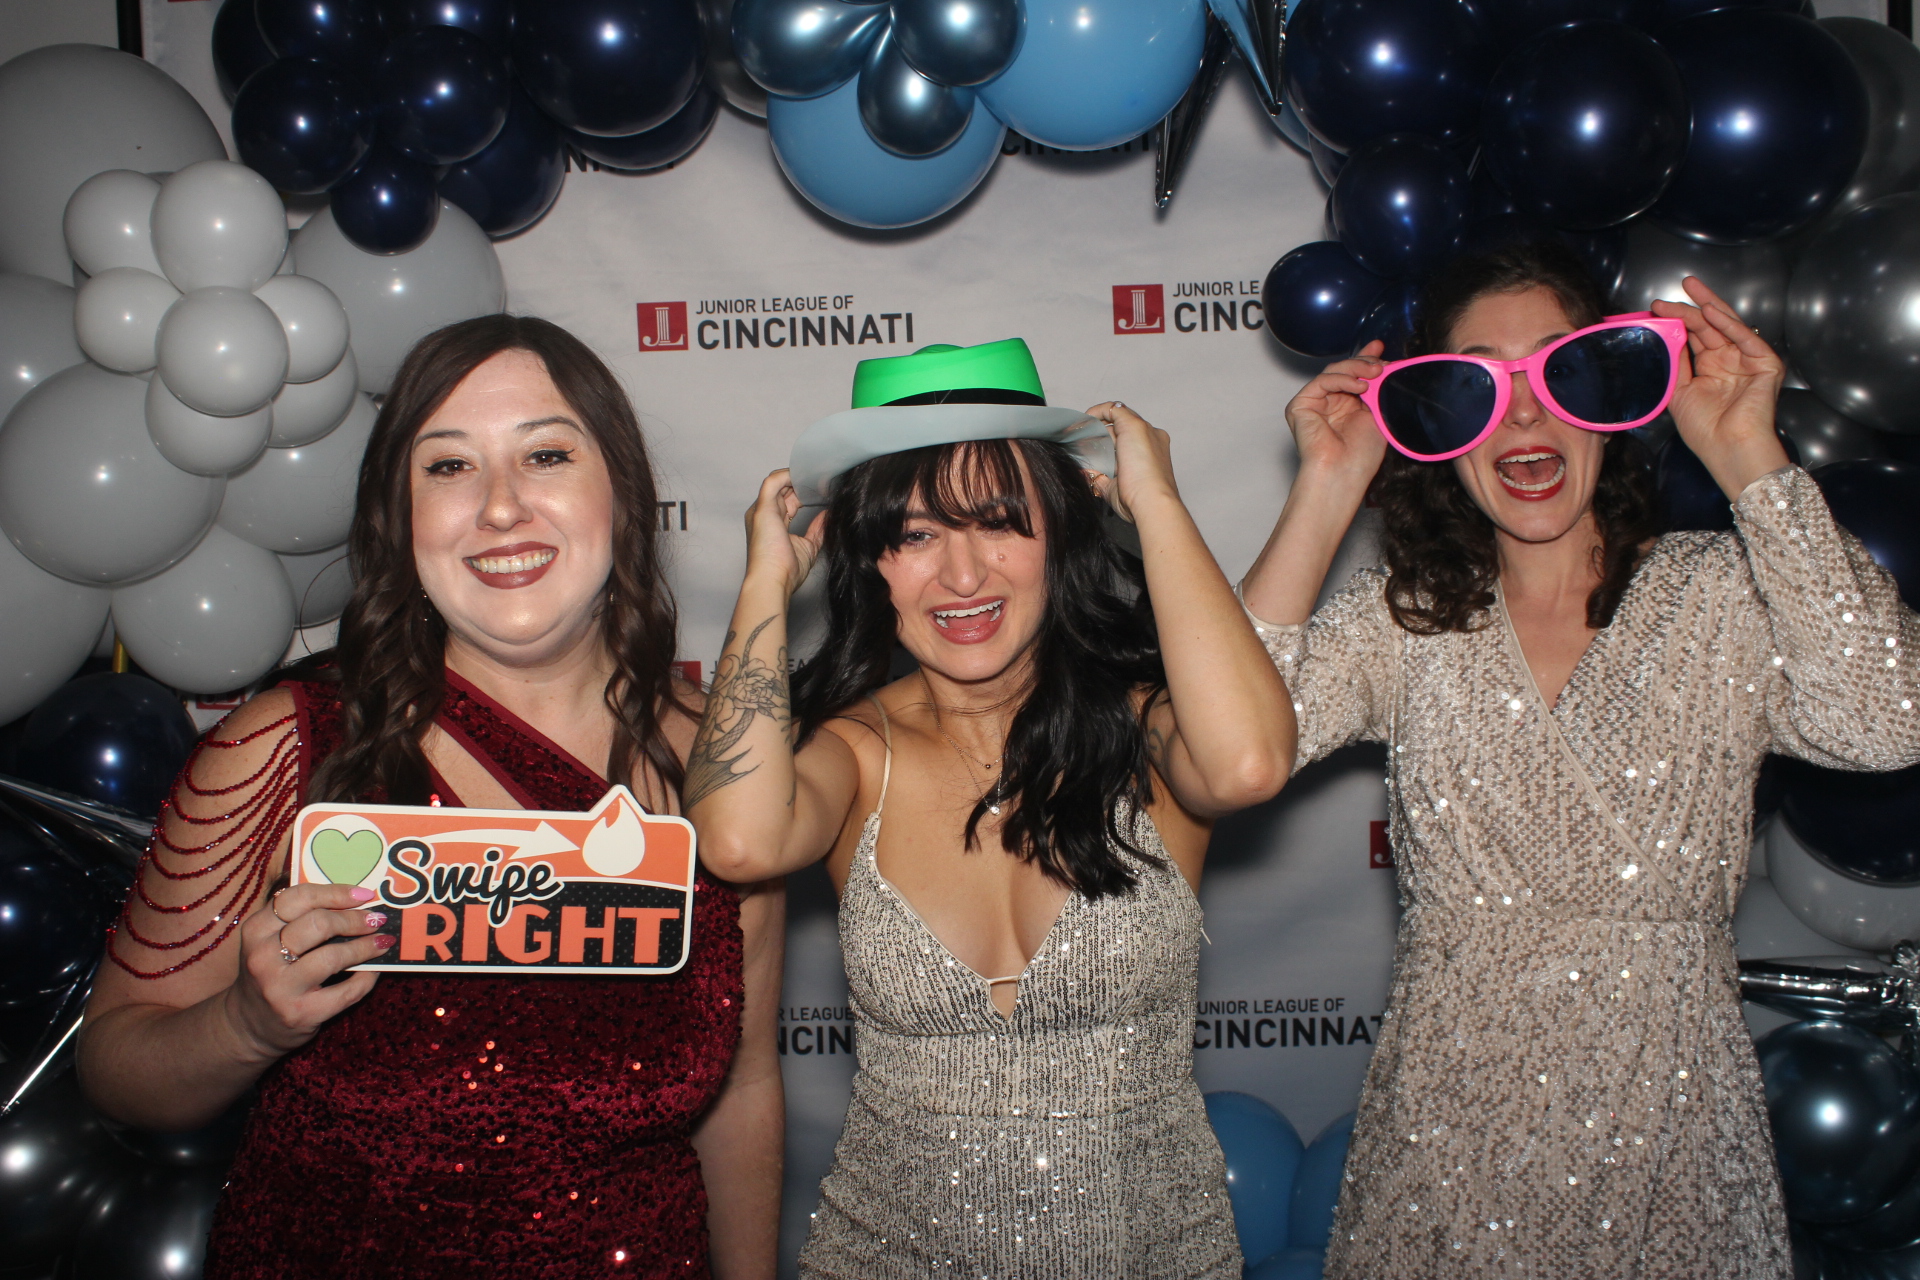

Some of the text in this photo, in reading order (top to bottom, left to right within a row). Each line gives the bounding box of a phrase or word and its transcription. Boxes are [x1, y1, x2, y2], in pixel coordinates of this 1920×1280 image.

[1173, 280, 1262, 298] JUNIOR LE
[696, 295, 854, 315] JUNIOR LEAGUE OF
[697, 312, 914, 351] CINCINNATI
[379, 839, 562, 925] Swipe
[399, 903, 680, 965] RIGHT
[790, 1006, 855, 1021] LEAGUE
[1196, 997, 1346, 1016] UNIOR LEAGUE OF
